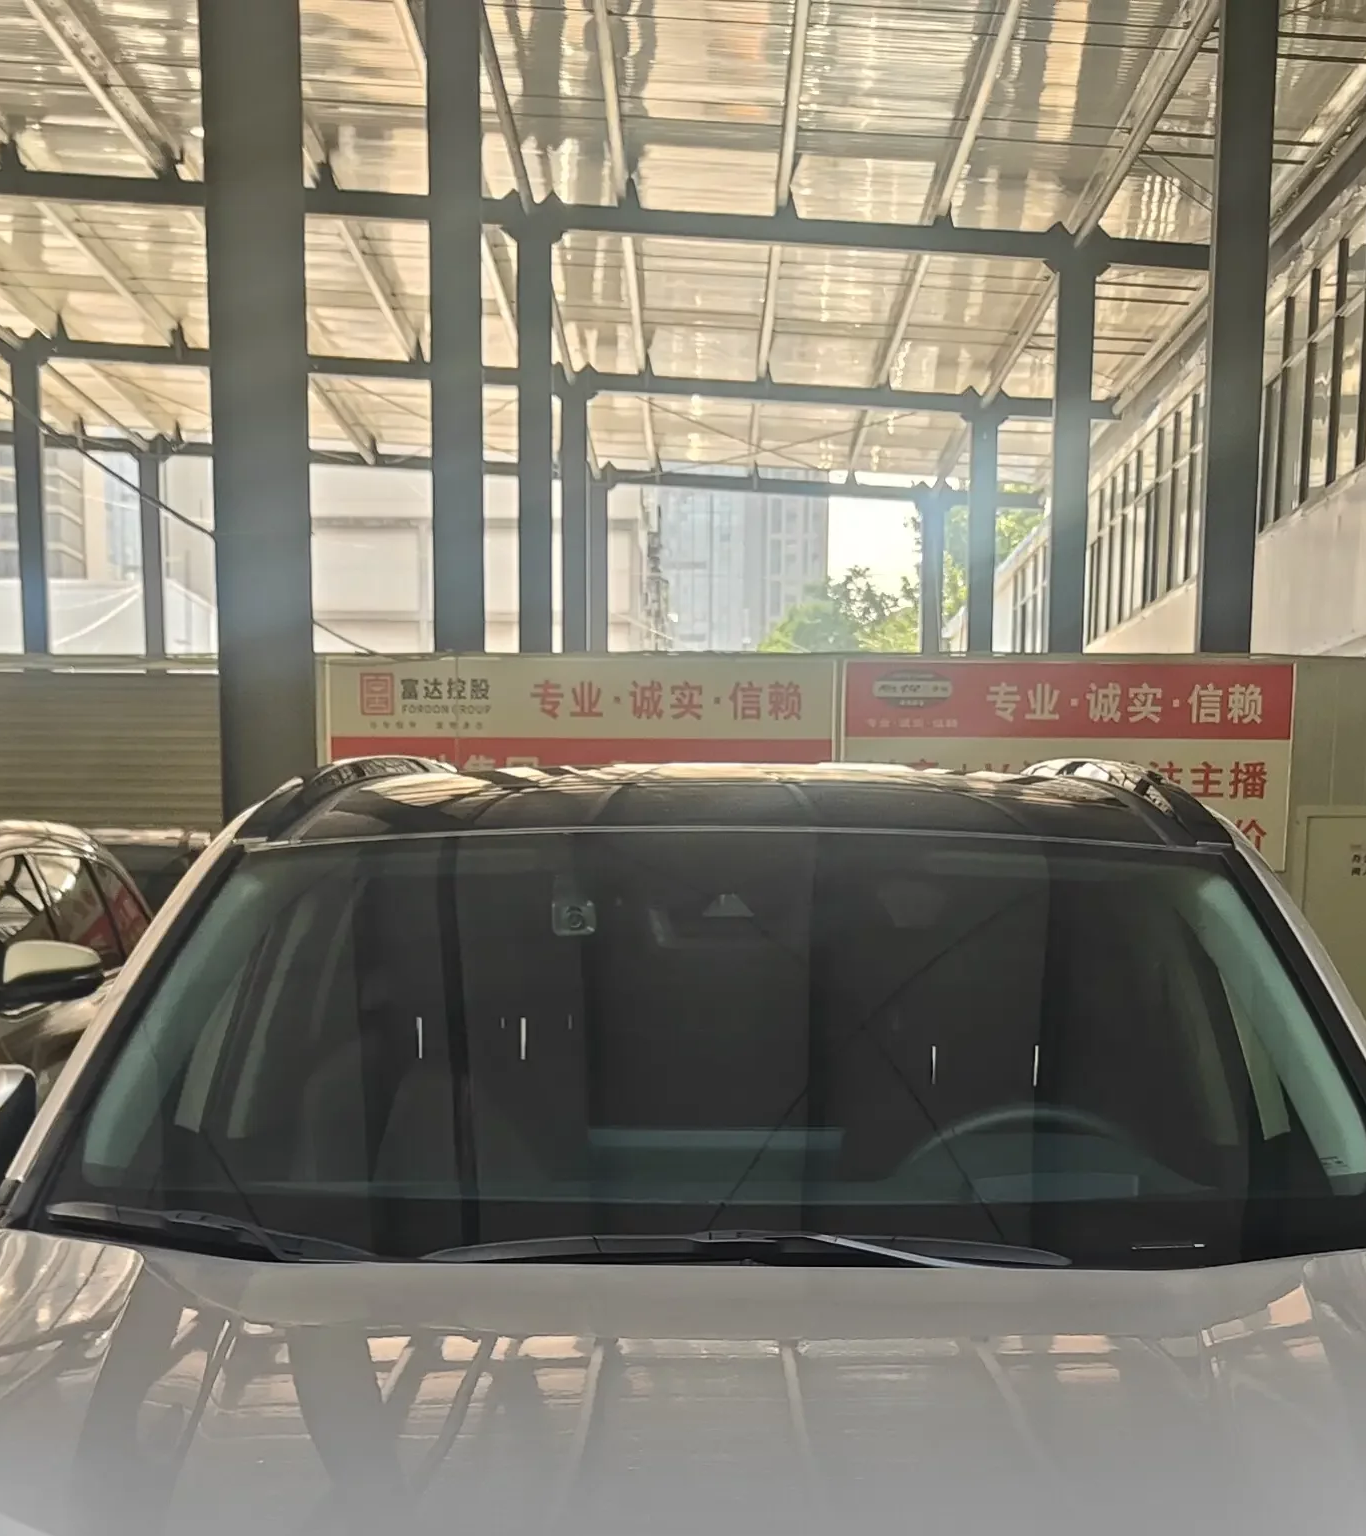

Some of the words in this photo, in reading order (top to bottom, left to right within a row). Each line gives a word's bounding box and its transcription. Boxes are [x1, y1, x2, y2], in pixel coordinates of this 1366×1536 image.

[400, 678, 490, 700] 富达控股
[530, 679, 802, 721] 专业·诚实·信赖
[986, 682, 1264, 724] 专业·诚实·信赖
